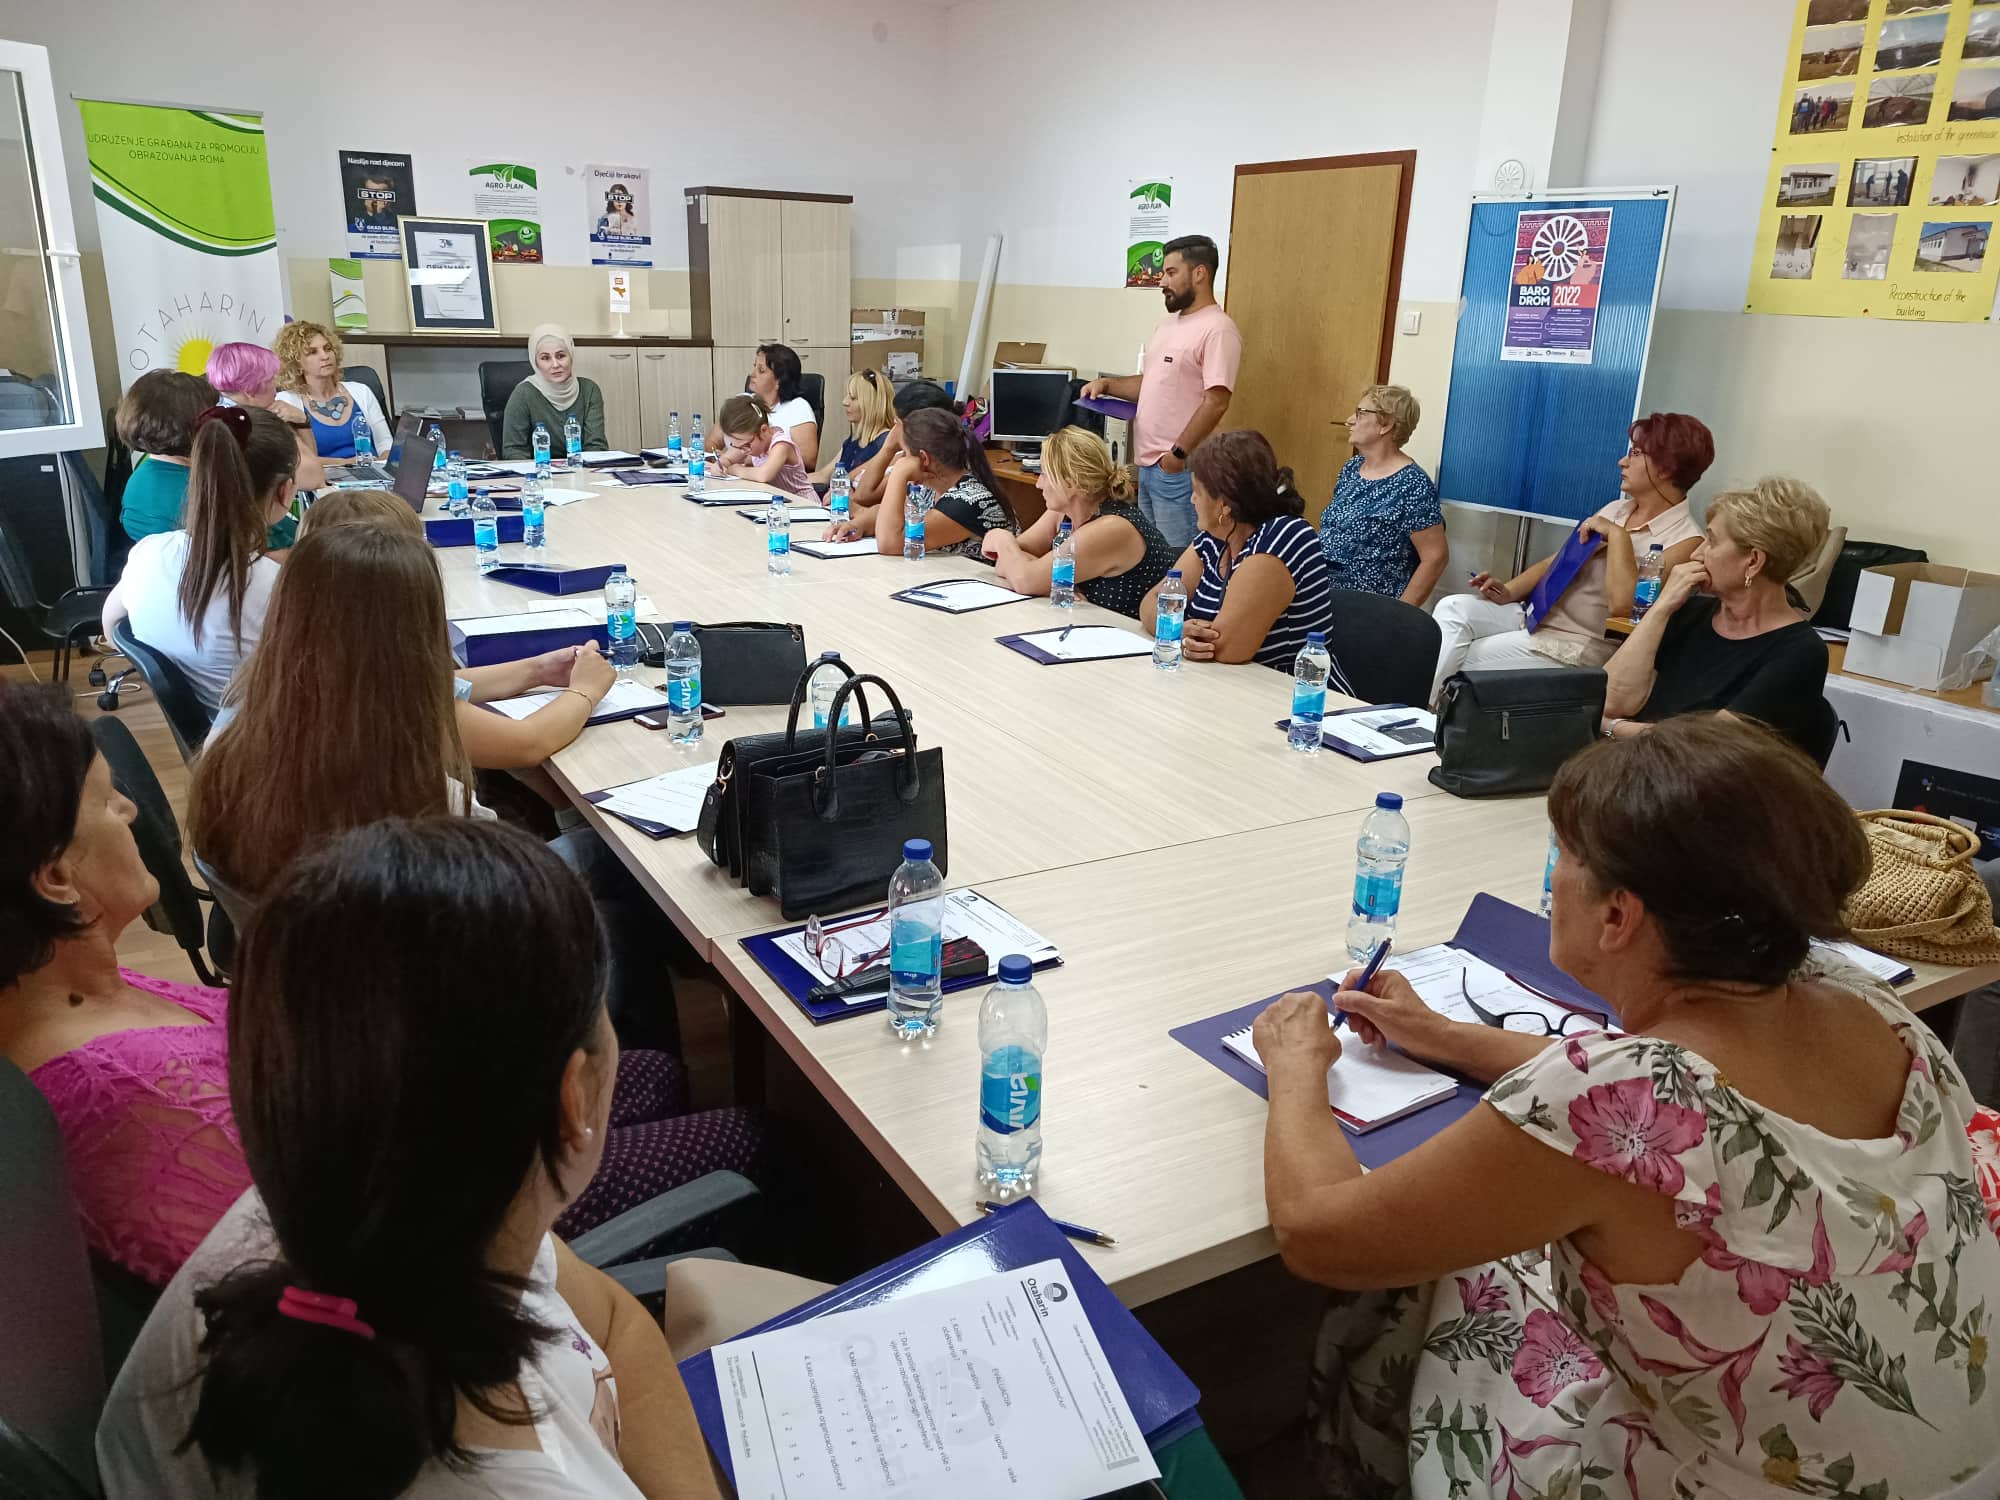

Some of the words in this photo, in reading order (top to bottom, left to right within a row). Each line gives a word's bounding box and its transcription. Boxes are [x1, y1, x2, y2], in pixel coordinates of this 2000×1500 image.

[195, 141, 207, 150] ZA
[209, 142, 260, 154] PROMOCIJU
[128, 150, 197, 162] OBRAZOVANJA
[200, 154, 225, 164] ROMA
[485, 182, 524, 190] AGRO-PLAN
[360, 190, 393, 199] STOP
[1519, 286, 1550, 296] BARO
[1553, 286, 1581, 306] 2022
[1518, 295, 1551, 306] DROM
[129, 291, 266, 371] OTAHARIN
[1027, 1278, 1048, 1317] Otaharin
